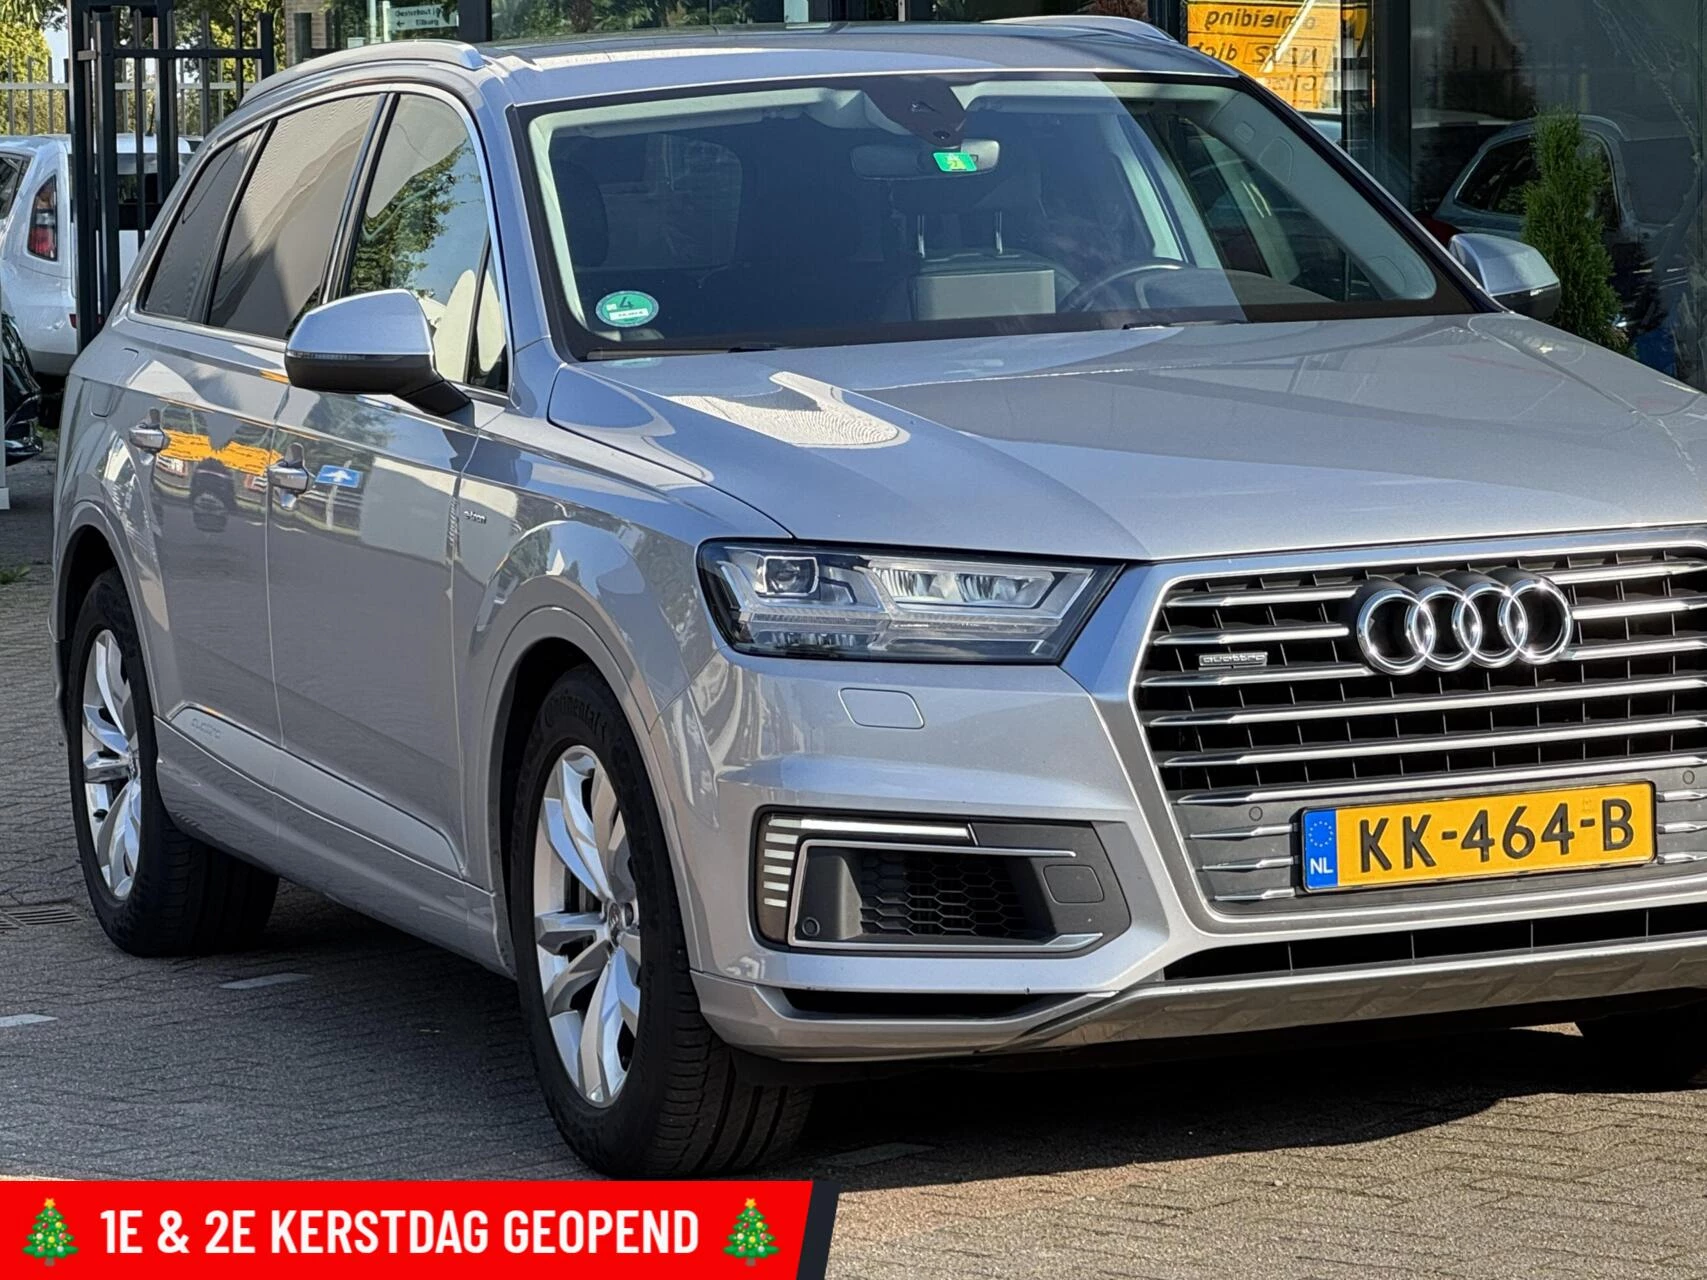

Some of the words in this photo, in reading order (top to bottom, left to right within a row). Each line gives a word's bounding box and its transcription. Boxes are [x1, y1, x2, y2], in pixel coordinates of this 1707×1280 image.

[1202, 653, 1265, 664] quattro
[1359, 798, 1635, 874] KK-464-B
[1309, 856, 1334, 875] NL
